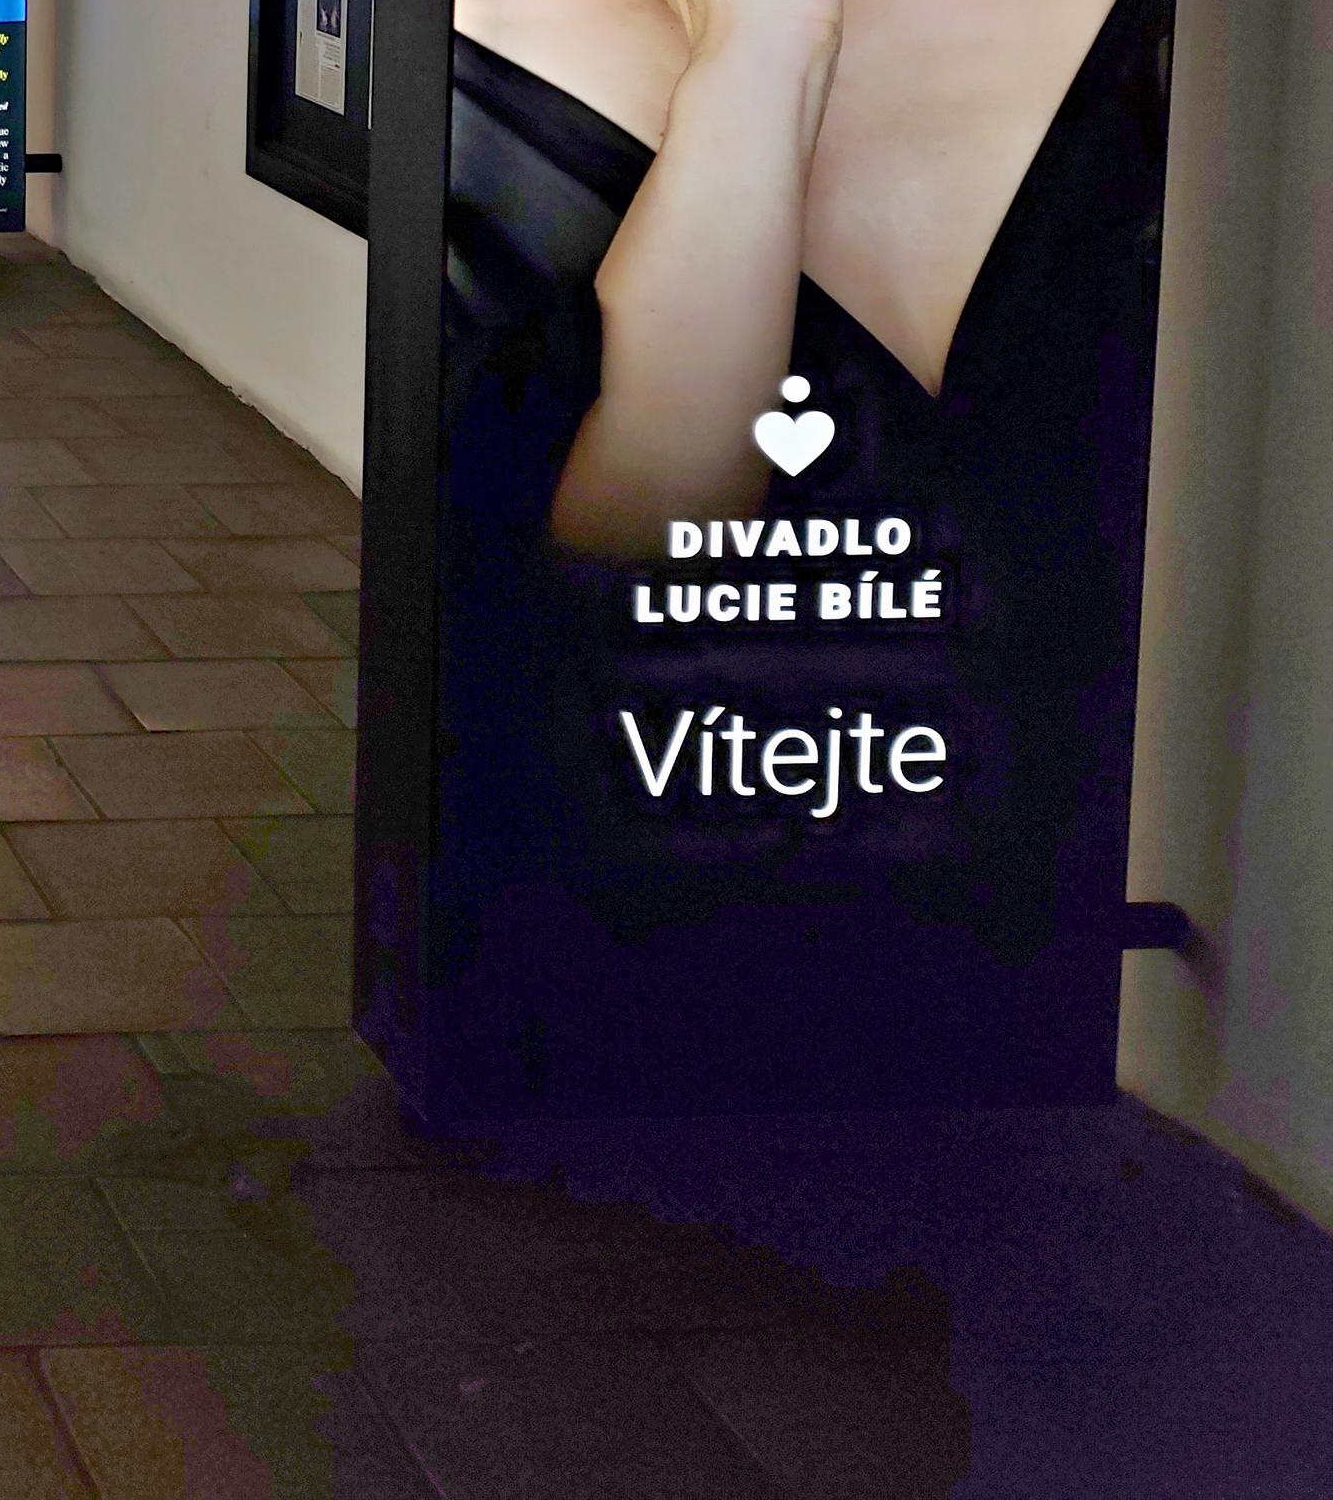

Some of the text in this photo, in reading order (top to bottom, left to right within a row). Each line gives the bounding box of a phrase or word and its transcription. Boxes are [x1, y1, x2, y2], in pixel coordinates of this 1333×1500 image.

[668, 518, 912, 558] DIVADLO
[635, 570, 942, 623] LUCIE BÍLÉ
[619, 706, 947, 818] Vítejte
